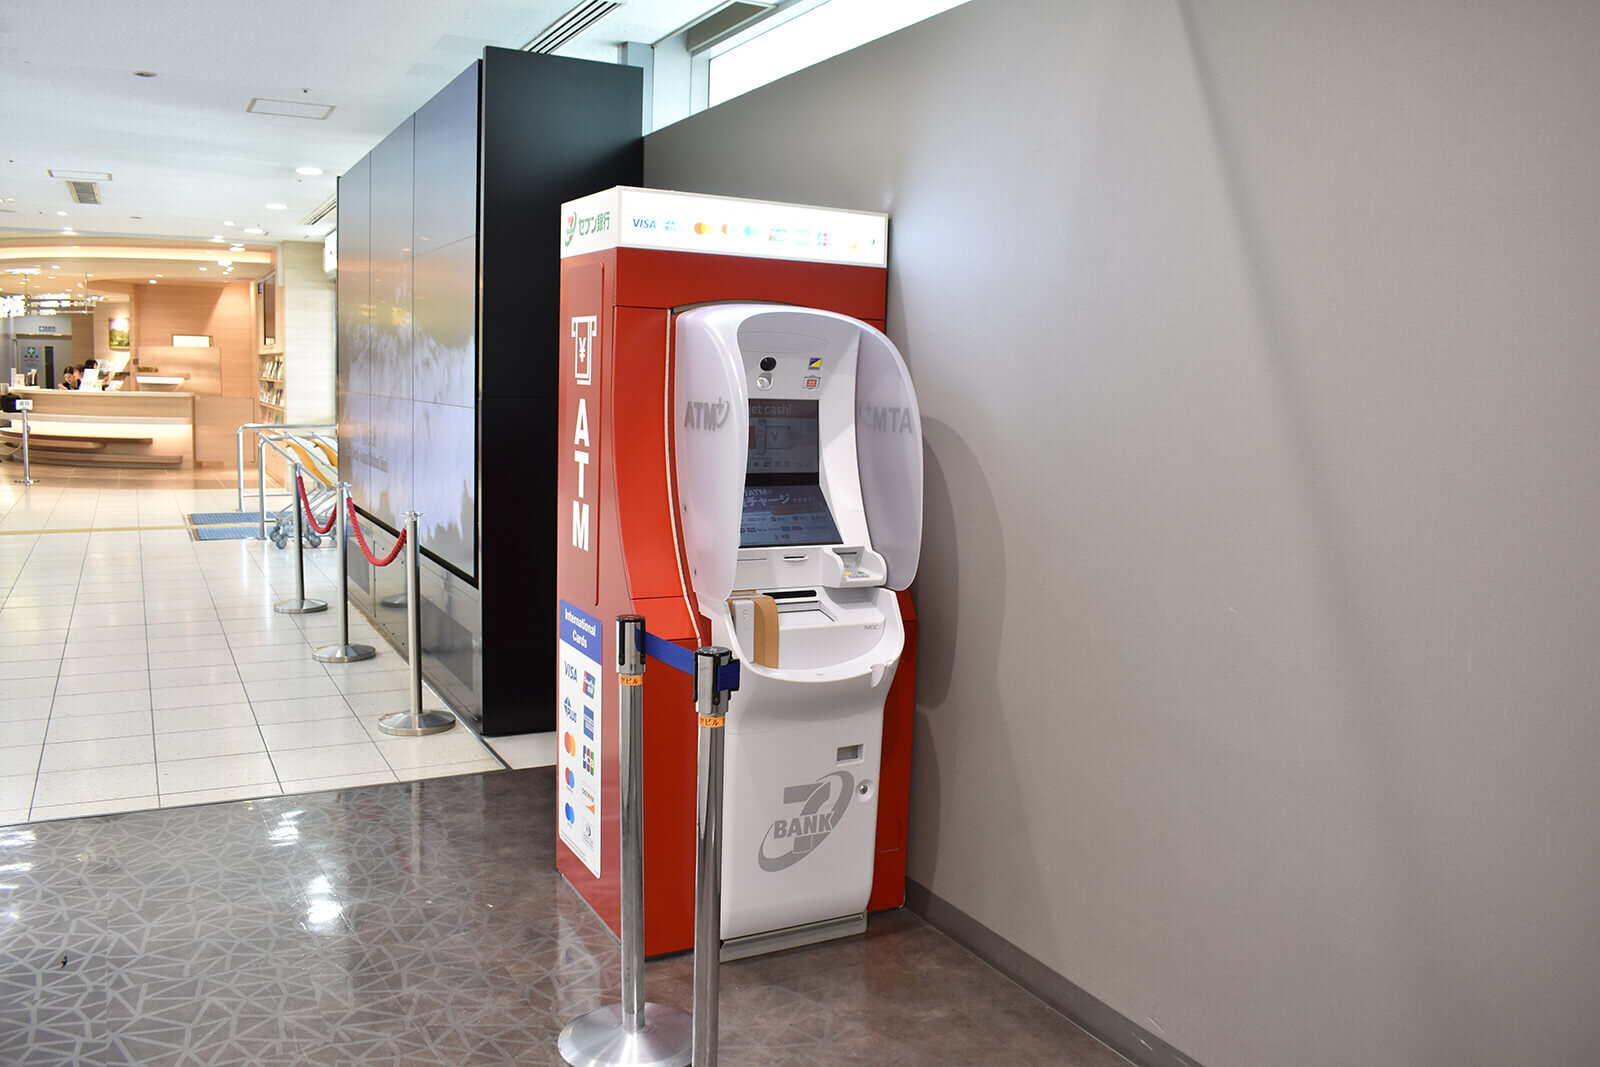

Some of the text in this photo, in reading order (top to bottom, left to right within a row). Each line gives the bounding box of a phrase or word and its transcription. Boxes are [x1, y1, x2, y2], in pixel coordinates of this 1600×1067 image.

[579, 211, 610, 236] セブン銀行
[632, 218, 656, 229] VISA
[684, 400, 716, 431] ATM
[572, 398, 590, 552] ATM
[564, 607, 596, 637] International
[572, 629, 587, 648] Cards
[564, 661, 577, 683] VISA
[773, 812, 832, 839] BANK
